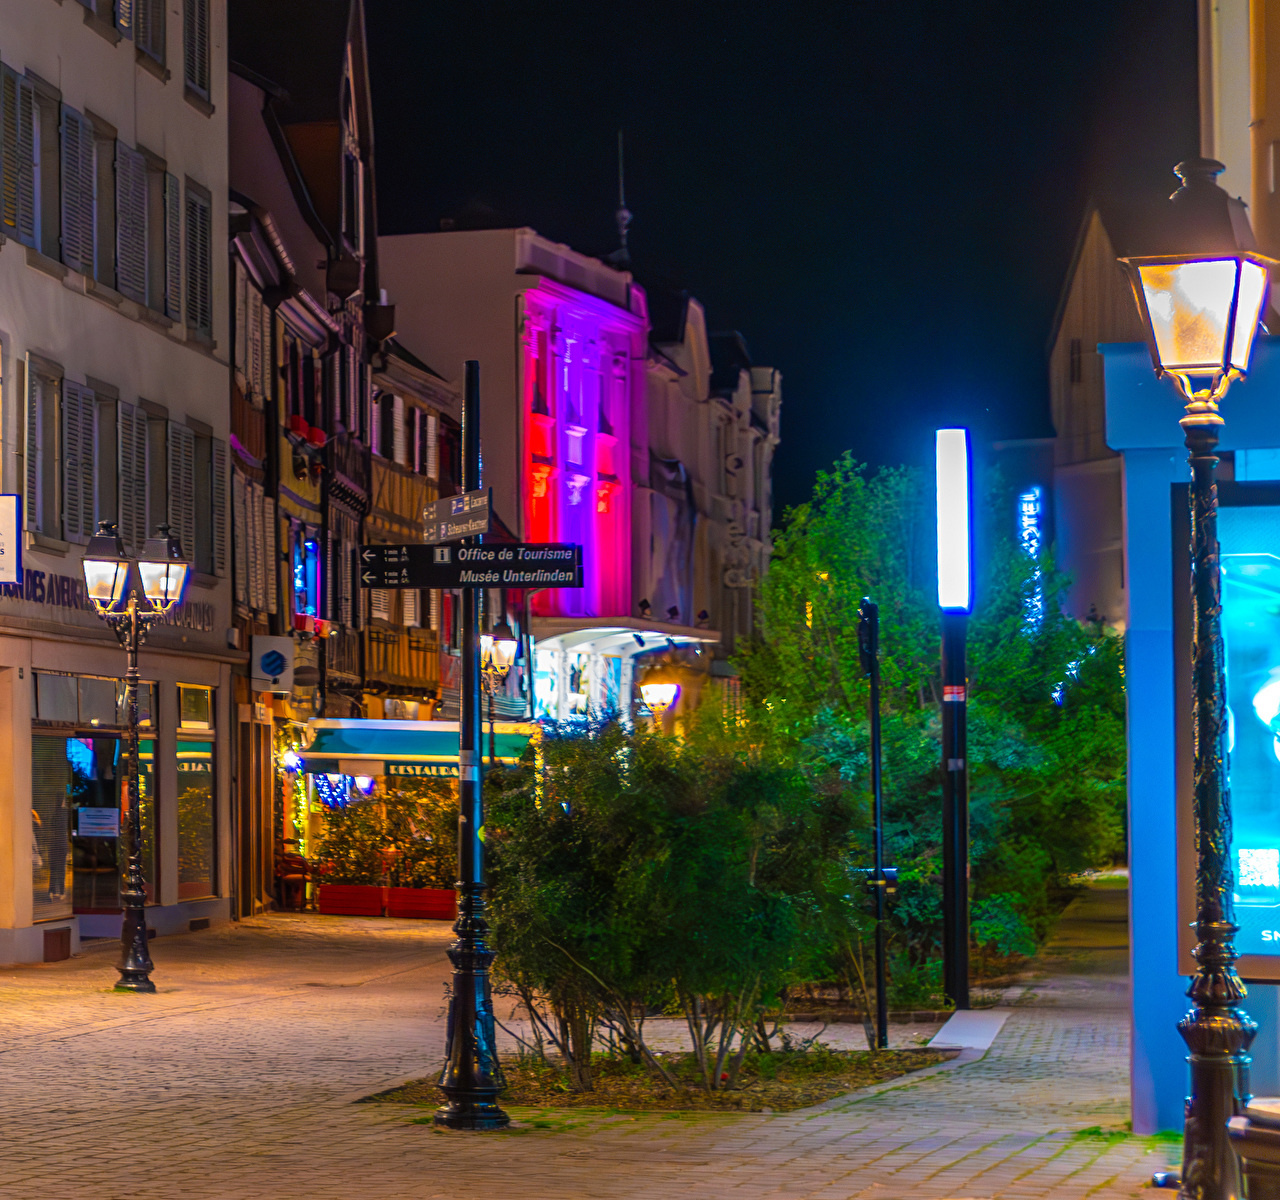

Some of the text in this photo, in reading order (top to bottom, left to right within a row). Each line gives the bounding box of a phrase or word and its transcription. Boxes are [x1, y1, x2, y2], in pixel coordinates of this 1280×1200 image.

[458, 548, 495, 561] Office
[498, 548, 513, 560] de
[517, 547, 572, 560] Tourisme
[460, 569, 574, 582] Musée Unterlinden
[25, 569, 45, 603] DES
[389, 765, 459, 776] RESTAURA
